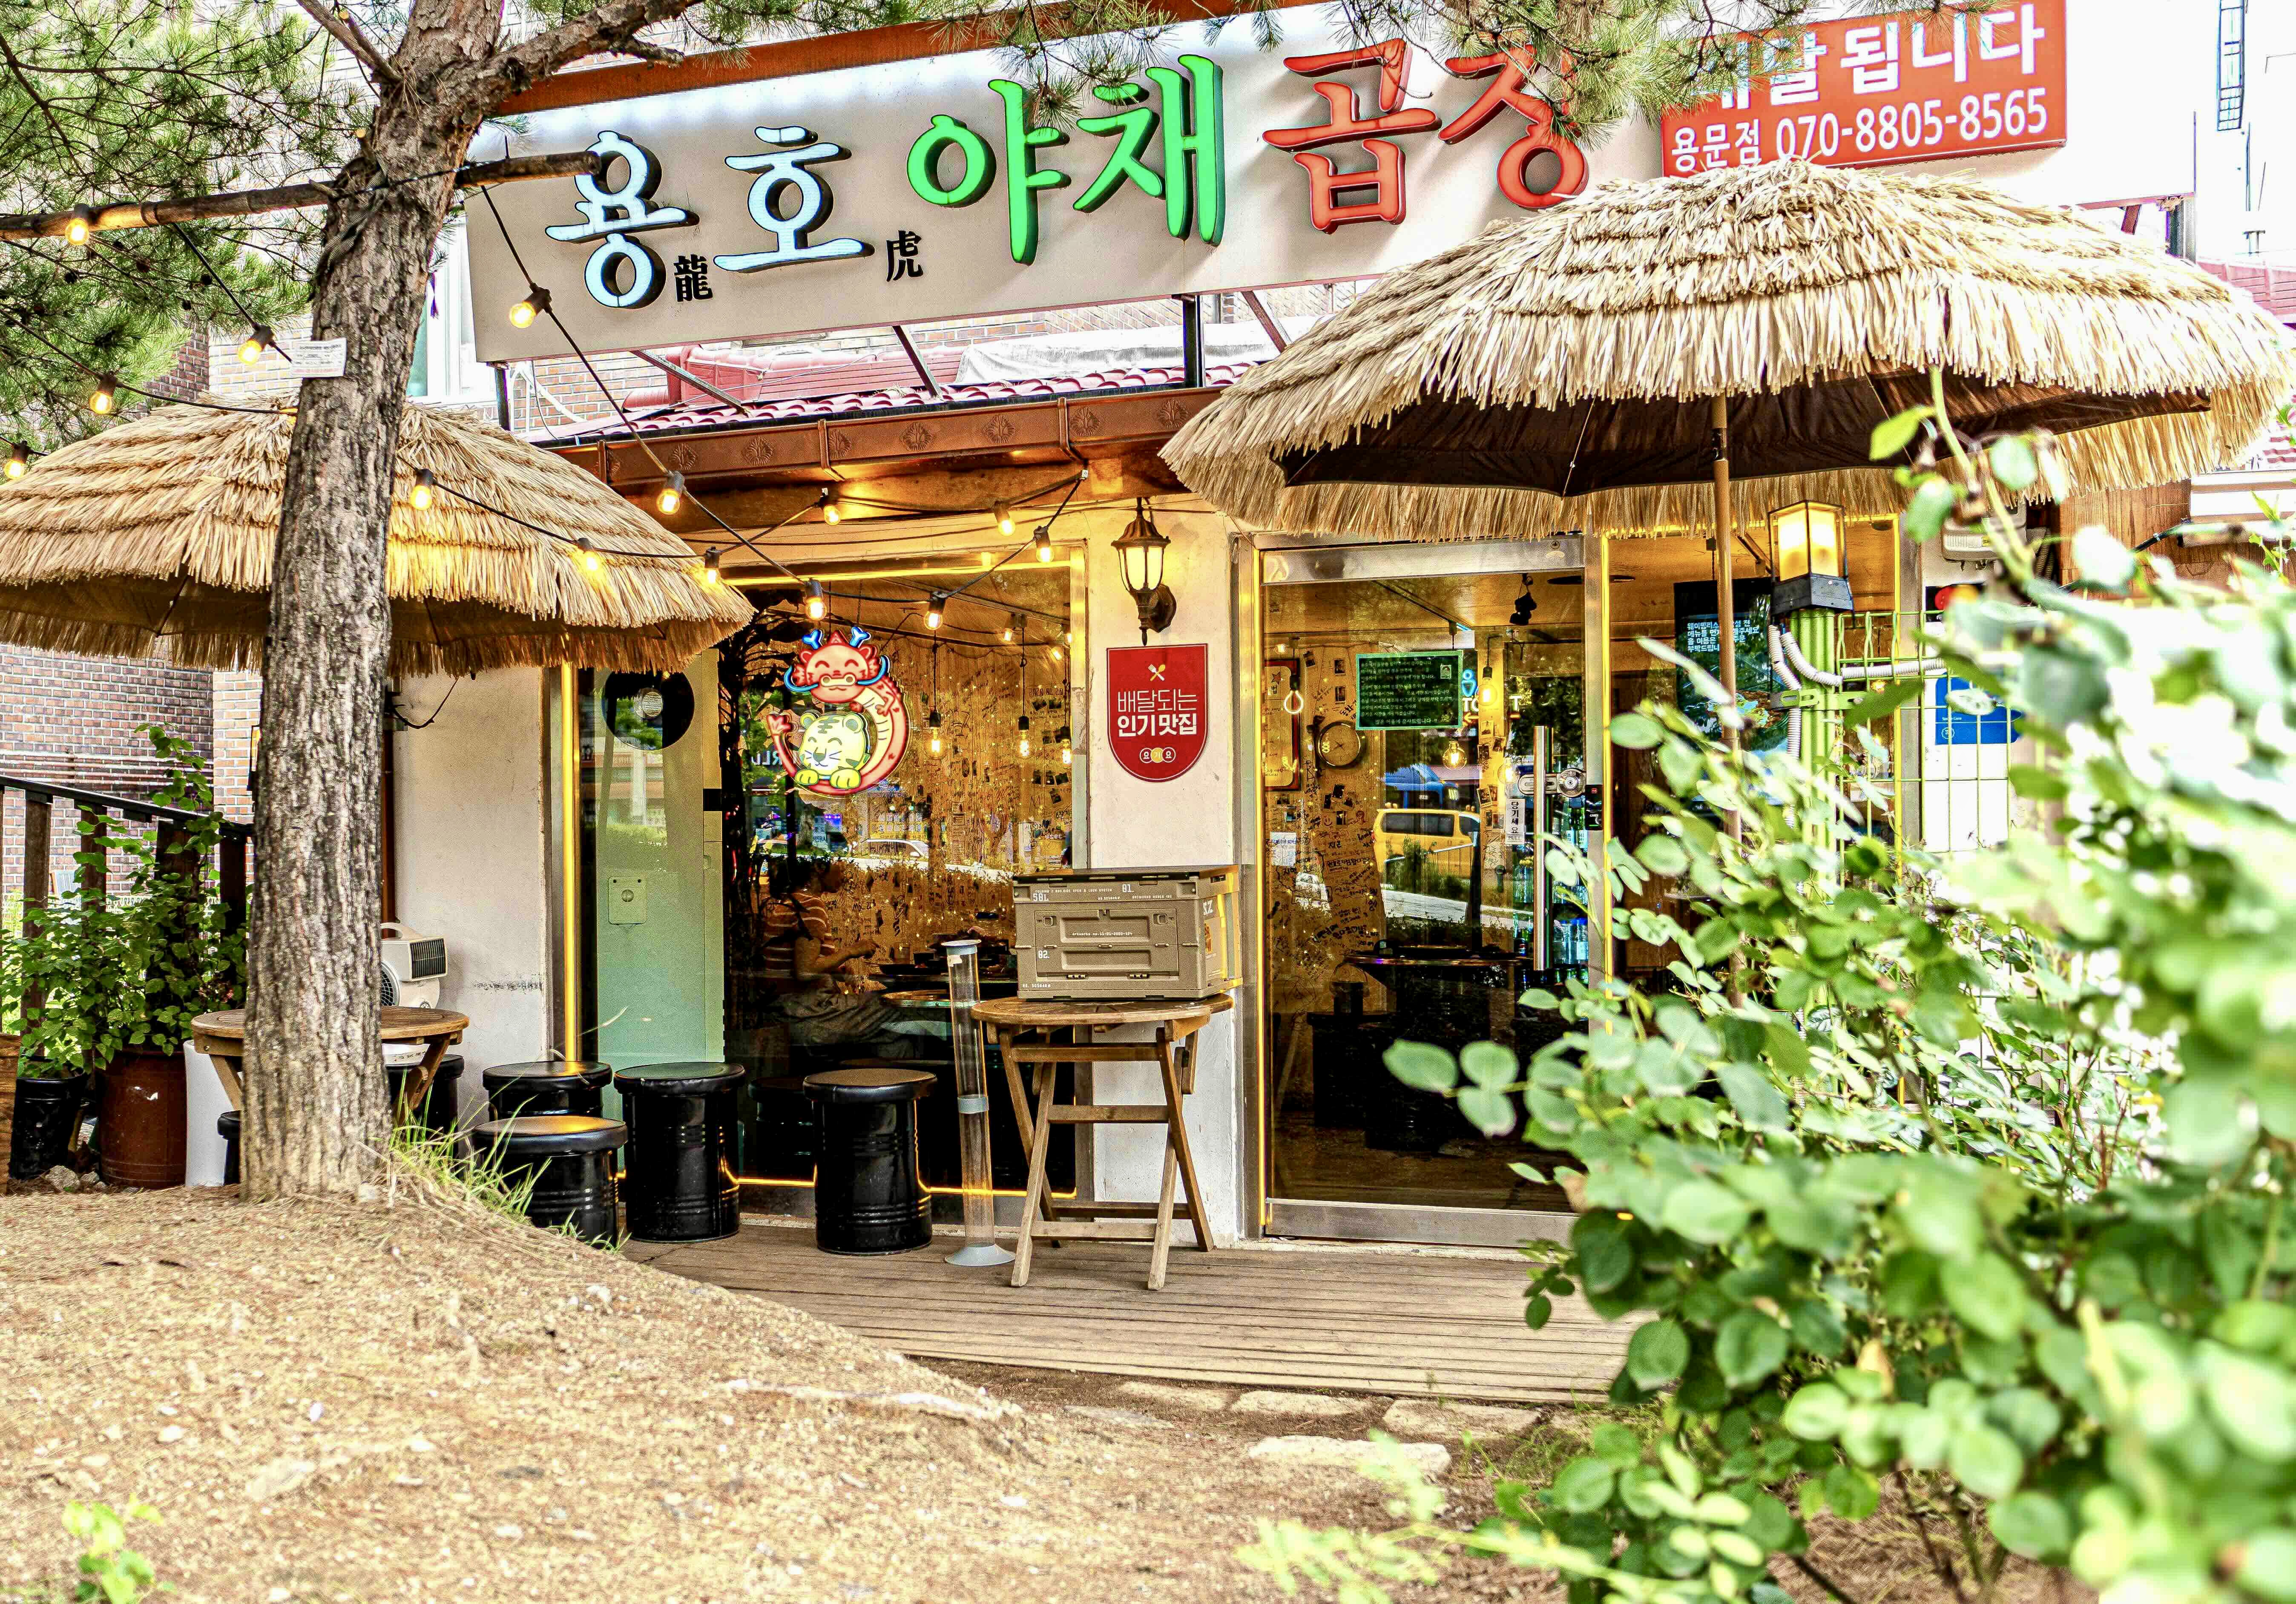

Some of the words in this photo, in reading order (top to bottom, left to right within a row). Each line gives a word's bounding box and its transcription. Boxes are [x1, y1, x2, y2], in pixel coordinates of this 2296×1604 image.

[1672, 119, 1762, 172] 용문점
[1776, 88, 2046, 160] 070-8805-8565
[906, 54, 1224, 265] 야채
[886, 230, 924, 282] 虎
[673, 254, 713, 303] 龍
[1687, 644, 1720, 653] 부탁드립니
[1118, 689, 1197, 713] 배달되는
[1117, 713, 1197, 737] 인기맛집
[1141, 749, 1174, 762] 요기요
[1511, 801, 1519, 834] 당기세요
